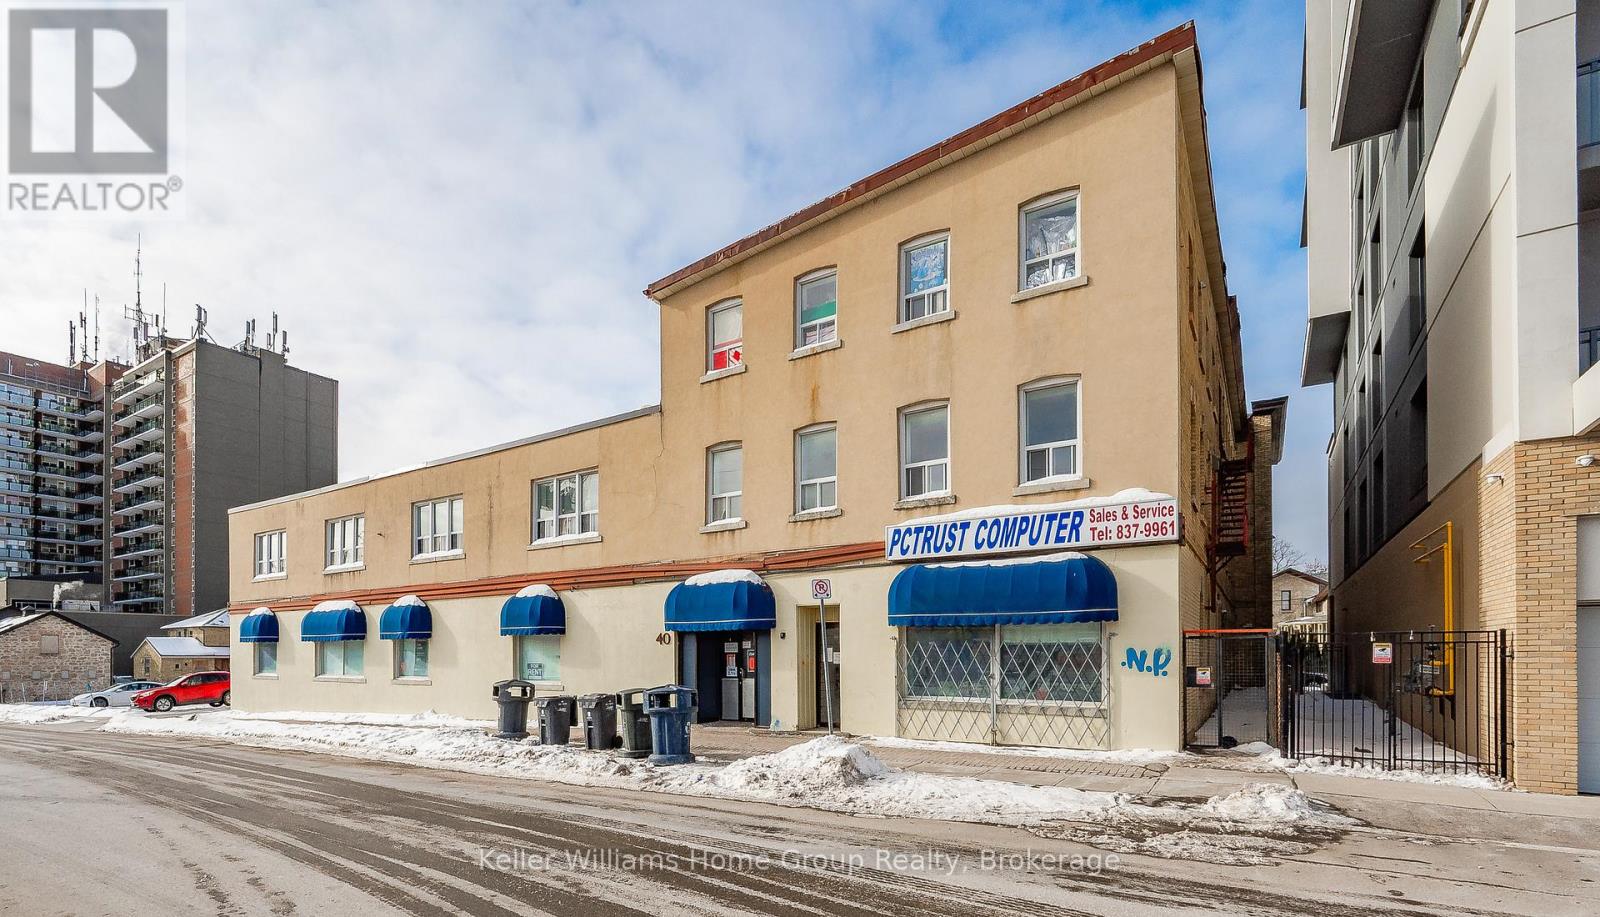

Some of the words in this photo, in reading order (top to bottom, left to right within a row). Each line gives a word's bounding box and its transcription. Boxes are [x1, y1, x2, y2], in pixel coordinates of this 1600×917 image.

[1089, 508, 1118, 524] Sales
[1121, 505, 1129, 521] &
[1132, 502, 1175, 520] Service
[888, 521, 971, 557] PCTRUST
[974, 510, 1085, 550] COMPUTER
[1089, 526, 1112, 542] Tel:
[1116, 520, 1175, 540] 837-9961
[655, 632, 671, 646] 40
[527, 668, 543, 677] RENT
